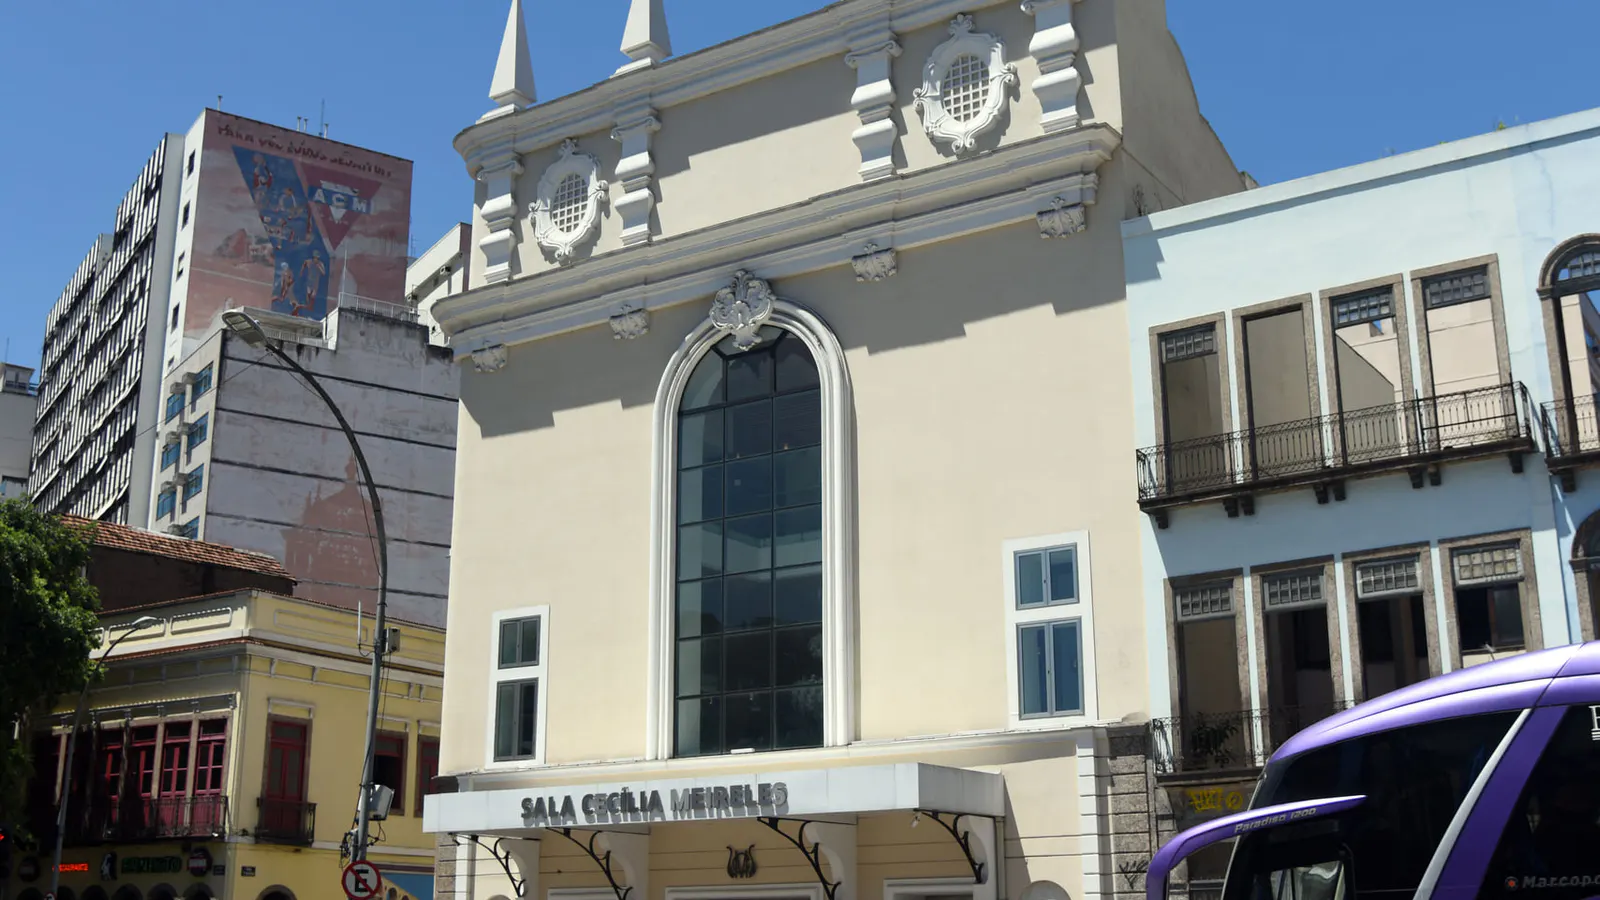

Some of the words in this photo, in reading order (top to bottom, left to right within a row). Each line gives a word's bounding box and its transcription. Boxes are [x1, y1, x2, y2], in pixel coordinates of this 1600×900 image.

[312, 188, 367, 213] ACM
[520, 795, 576, 821] SALA
[581, 786, 664, 817] CECÍLIA
[669, 781, 789, 813] MEIRELES
[1234, 814, 1287, 834] Paradiso
[1290, 807, 1317, 819] 1200
[354, 868, 370, 893] E
